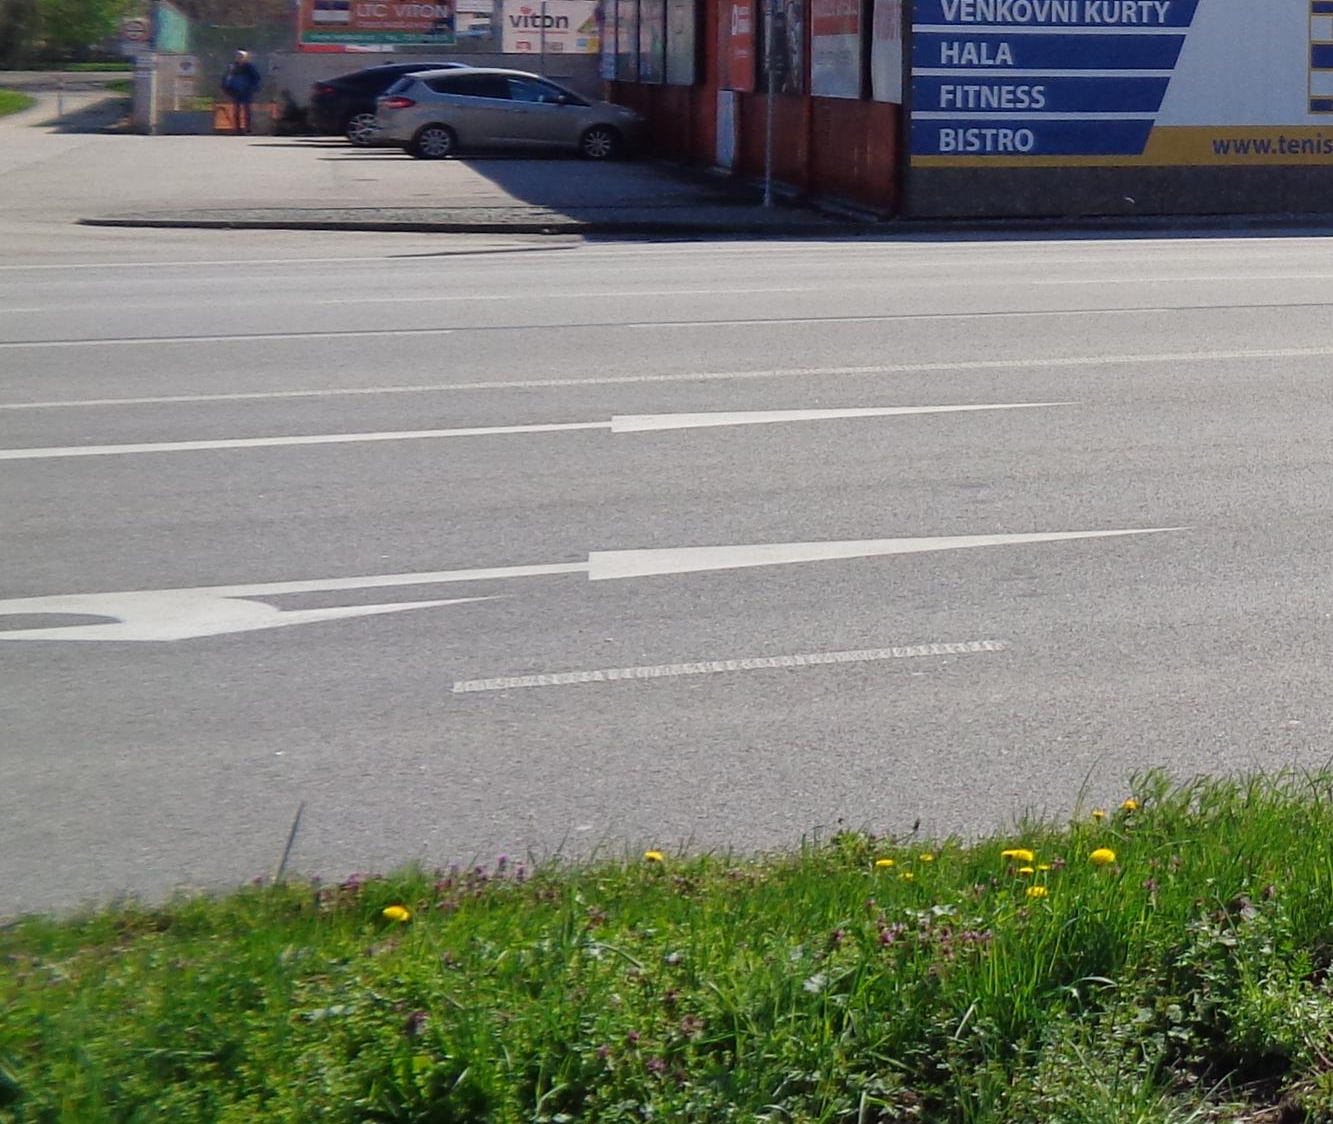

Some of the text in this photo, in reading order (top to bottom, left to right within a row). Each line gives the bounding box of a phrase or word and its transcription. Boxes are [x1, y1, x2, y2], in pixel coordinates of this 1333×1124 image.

[355, 4, 449, 19] LTC VITON
[509, 7, 569, 28] viton
[1085, 0, 1171, 23] KURTY
[940, 41, 1013, 66] HALA
[939, 84, 1046, 109] FITNESS
[938, 128, 1034, 153] BISTRO
